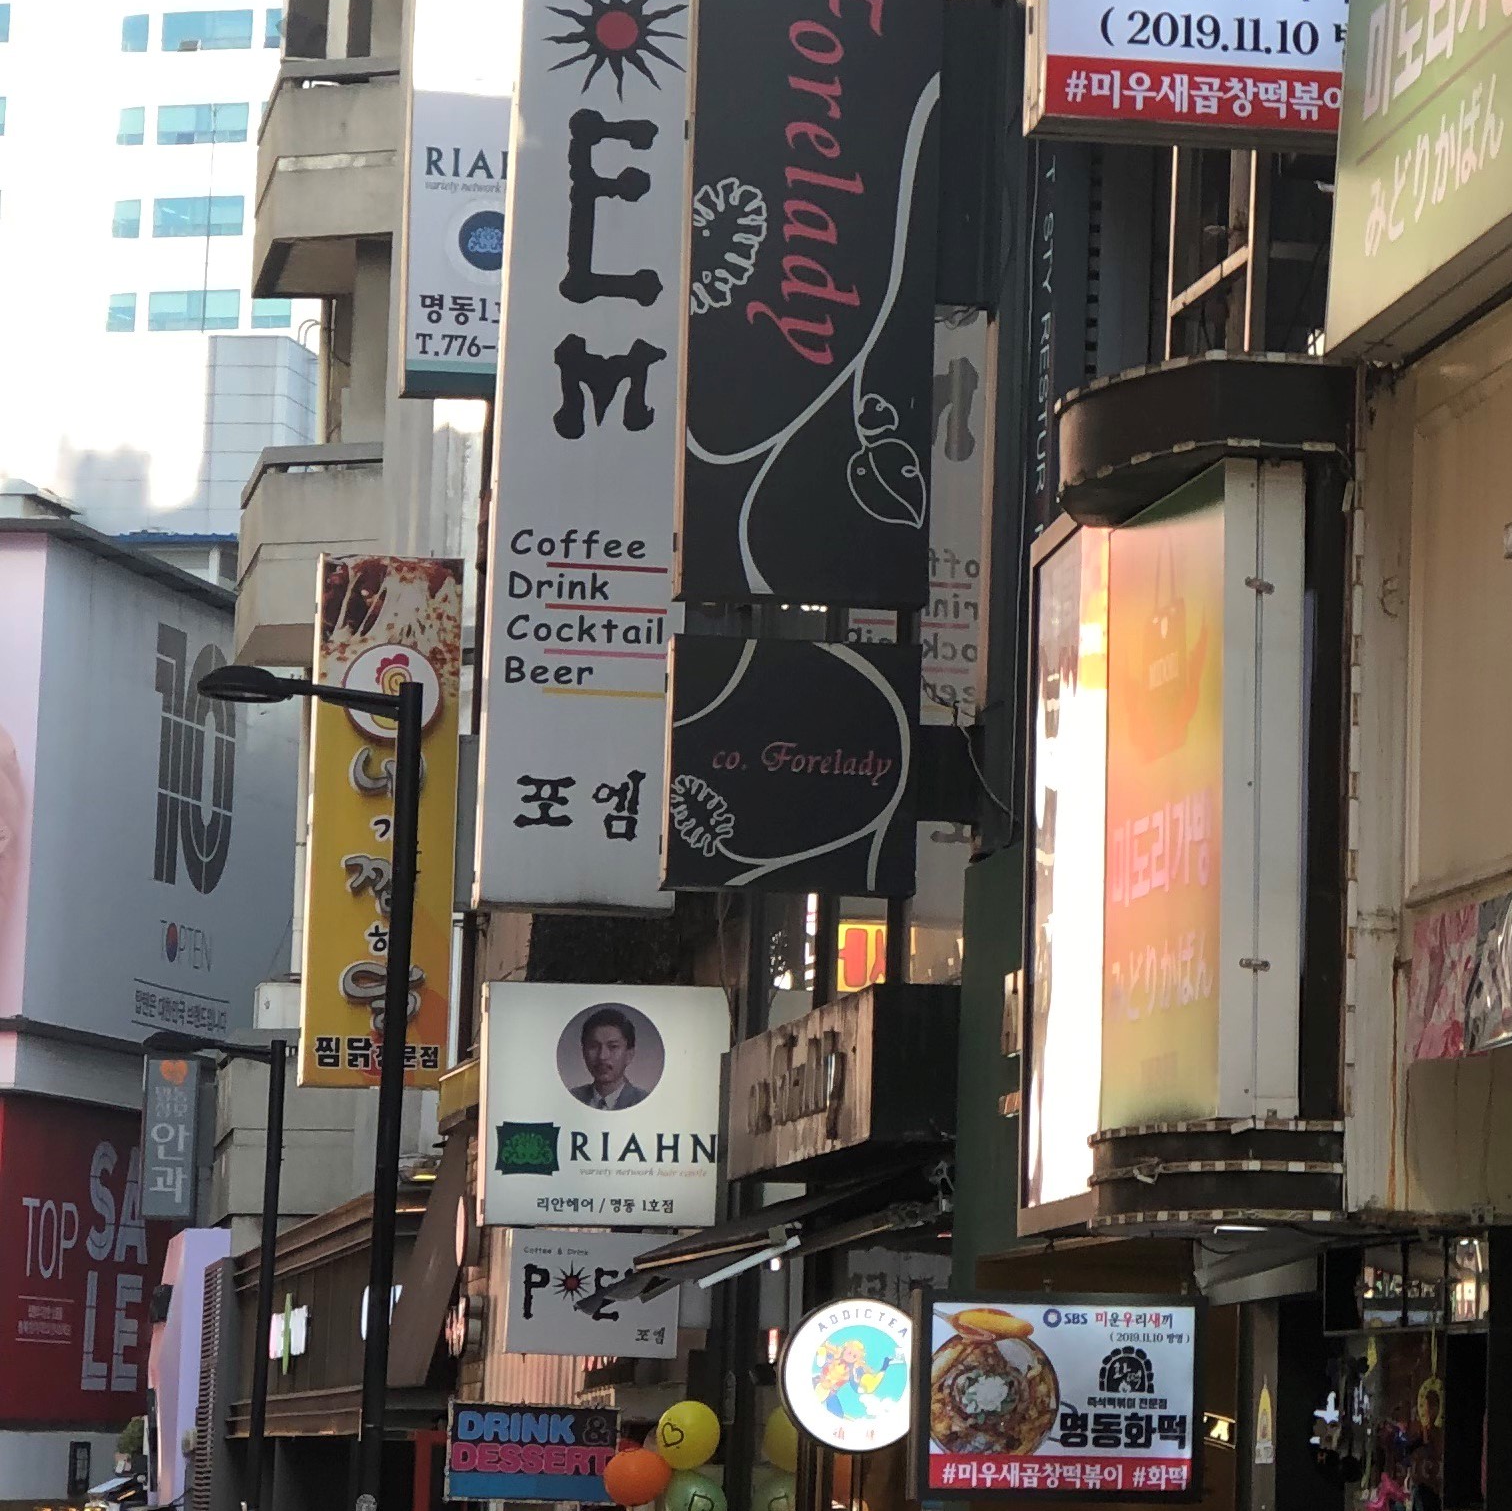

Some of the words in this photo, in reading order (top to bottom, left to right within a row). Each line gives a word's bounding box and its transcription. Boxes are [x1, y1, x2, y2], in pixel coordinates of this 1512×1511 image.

[1364, 73, 1505, 258] みどりかばん
[415, 332, 499, 358] T.776-
[510, 529, 647, 560] Coffee
[507, 570, 611, 602] Drink
[506, 613, 665, 646] Cocktail
[503, 657, 594, 686] Beer
[760, 740, 893, 786] Forelady
[512, 770, 647, 842] 포엠
[569, 1130, 719, 1165] RIAHN
[536, 1197, 595, 1213] 리안헤어
[609, 1197, 636, 1214] 명동
[642, 1198, 675, 1214] 1호점
[22, 1196, 80, 1280] TOP
[1063, 1312, 1089, 1326] SBS
[1094, 1311, 1174, 1330] 미운우리새끼
[456, 1409, 576, 1444] DRINK
[1059, 1411, 1188, 1451] 명동화떡
[450, 1441, 616, 1475] DESSERT
